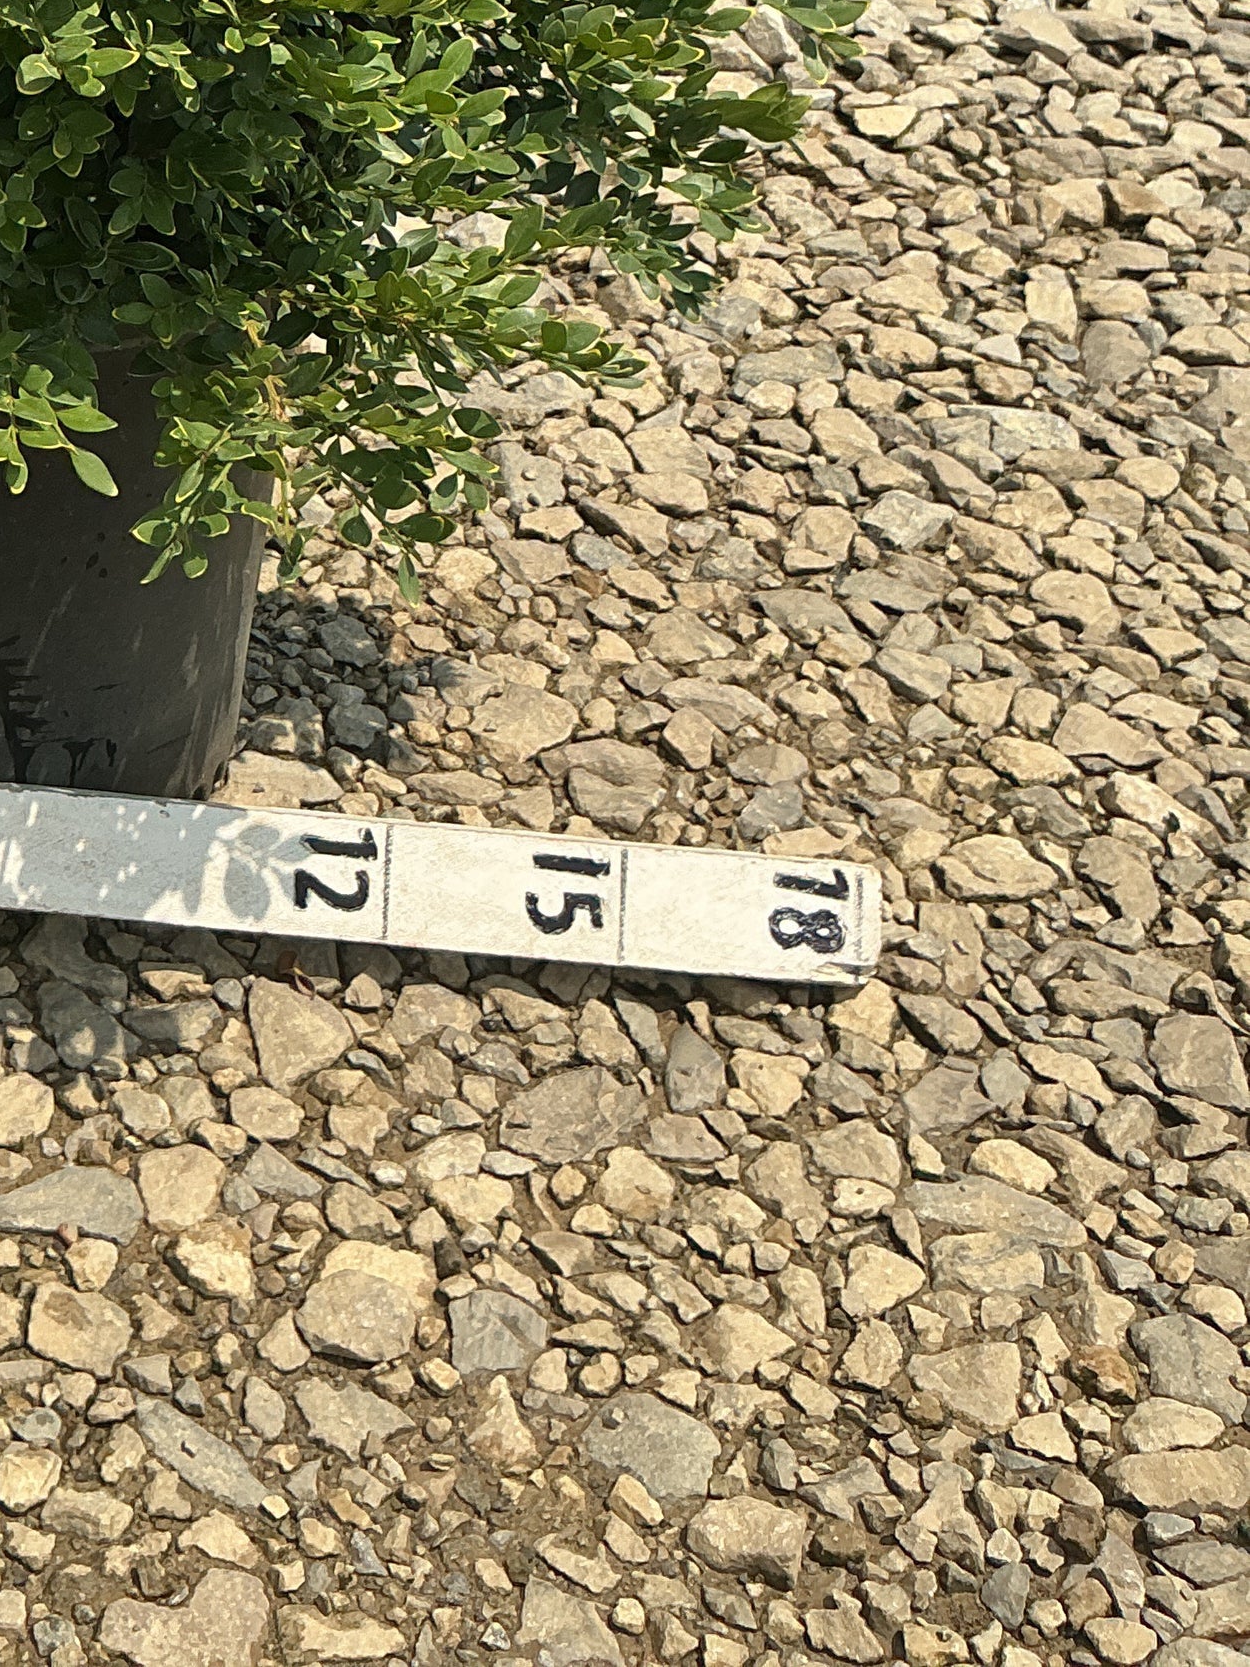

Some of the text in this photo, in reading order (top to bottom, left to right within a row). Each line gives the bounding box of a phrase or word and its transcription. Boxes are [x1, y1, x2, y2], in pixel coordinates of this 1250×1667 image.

[293, 828, 378, 911] 12
[525, 852, 611, 935] 15
[768, 868, 849, 953] 18
